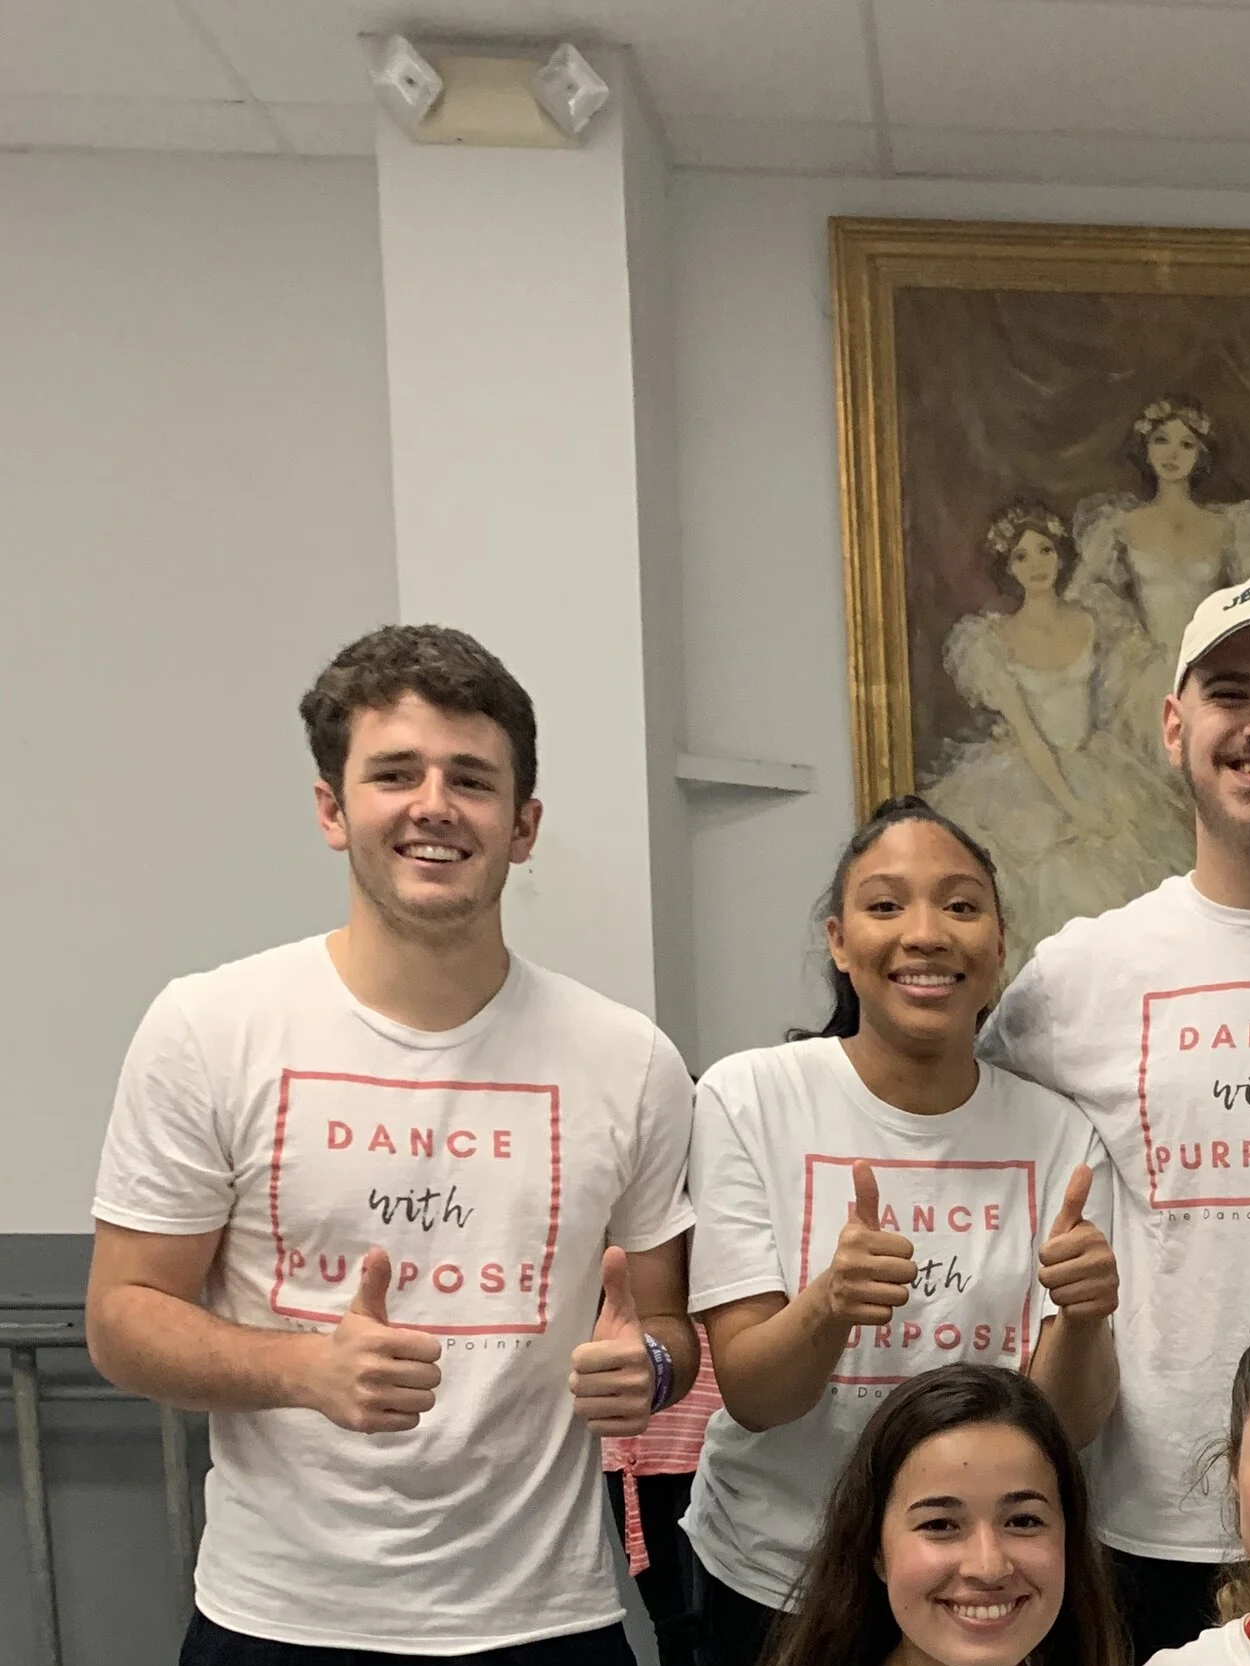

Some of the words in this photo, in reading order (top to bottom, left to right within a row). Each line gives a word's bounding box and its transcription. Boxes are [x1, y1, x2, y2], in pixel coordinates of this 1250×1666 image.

[327, 1120, 512, 1159] DANCE
[369, 1186, 474, 1232] with
[848, 1201, 1000, 1232] ANCE
[289, 1247, 535, 1294] PUPOSE
[911, 1256, 972, 1296] th
[446, 1338, 534, 1350] Pointe
[845, 1321, 1016, 1353] URPOSE
